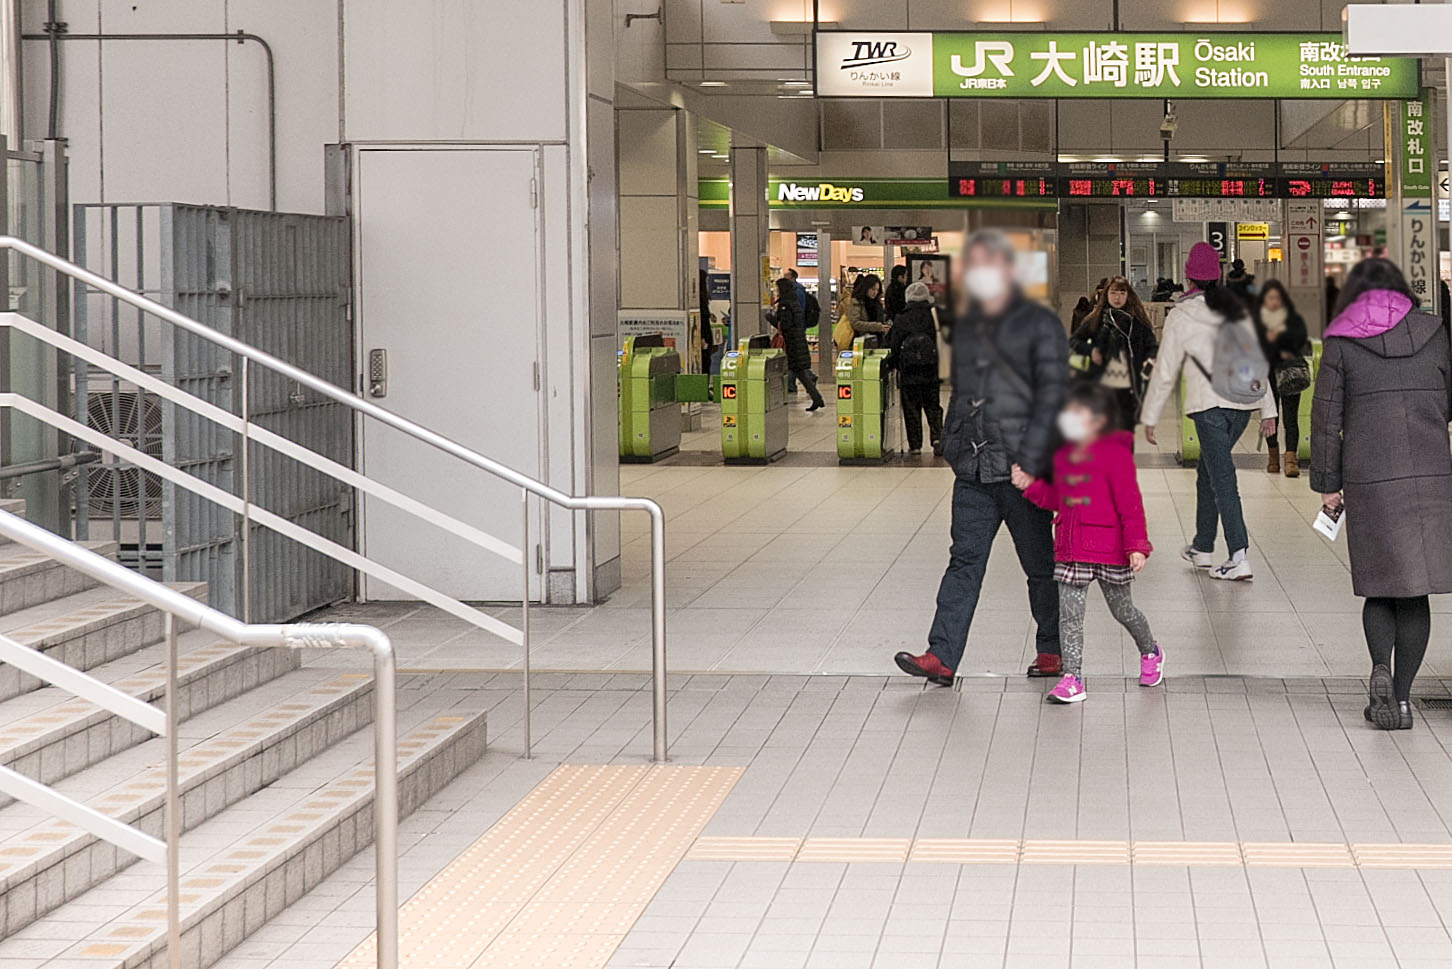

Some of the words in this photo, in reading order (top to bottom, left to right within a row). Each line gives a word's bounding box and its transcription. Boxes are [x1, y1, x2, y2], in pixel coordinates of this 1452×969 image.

[951, 41, 1015, 76] JR
[1194, 39, 1255, 62] Ōsaki
[1030, 41, 1182, 87] 大崎駅
[1300, 64, 1335, 77] South
[1337, 64, 1390, 77] Entrance
[850, 71, 901, 81] りんかい線
[960, 78, 1007, 89] JR東日本
[1194, 67, 1268, 87] Station
[1300, 78, 1330, 89] 南入口
[1407, 100, 1424, 173] 南改札口
[778, 183, 864, 202] NewDays
[1211, 232, 1223, 250] 3
[1409, 219, 1427, 294] りんかい線
[723, 360, 737, 369] IC
[723, 387, 736, 398] IC
[839, 387, 851, 398] IC
